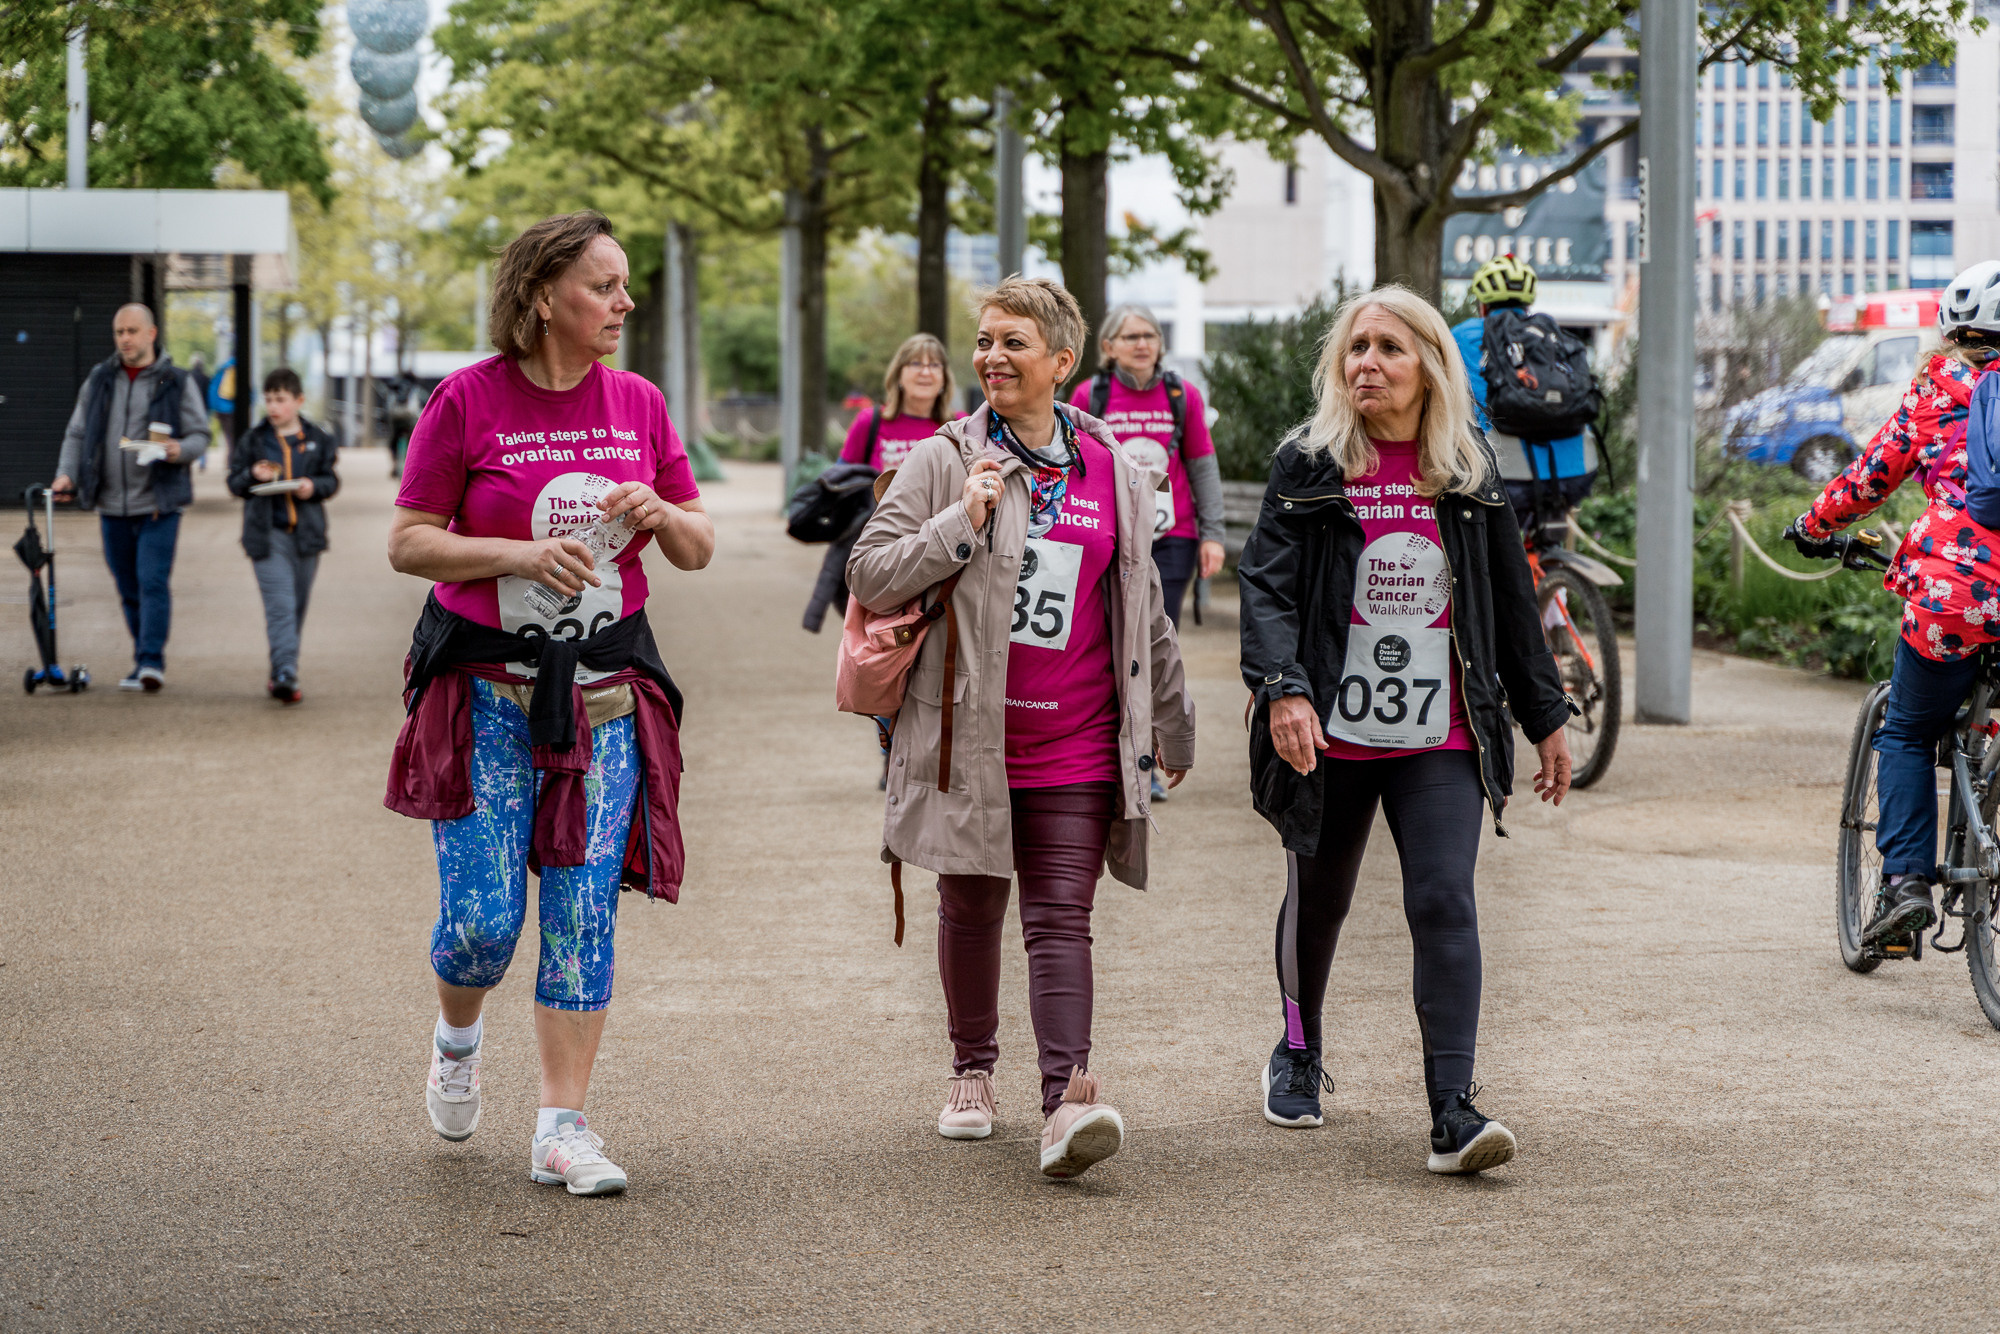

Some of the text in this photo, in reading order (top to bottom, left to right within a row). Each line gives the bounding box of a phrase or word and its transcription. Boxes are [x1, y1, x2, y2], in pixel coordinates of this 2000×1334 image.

[496, 425, 638, 446] Taking steps to beat
[502, 445, 641, 466] ovarian cancer
[1344, 485, 1382, 498] aking
[548, 497, 577, 510] The
[1071, 494, 1100, 511] beat
[549, 511, 601, 525] Ovaria
[1056, 511, 1100, 529] ncer
[1369, 559, 1396, 571] The
[1368, 574, 1425, 587] Ovarian
[1367, 589, 1418, 602] Cancer
[1010, 586, 1066, 638] 35
[1025, 701, 1059, 710] CANCER
[1338, 675, 1442, 726] 037
[1425, 736, 1442, 745] 037
